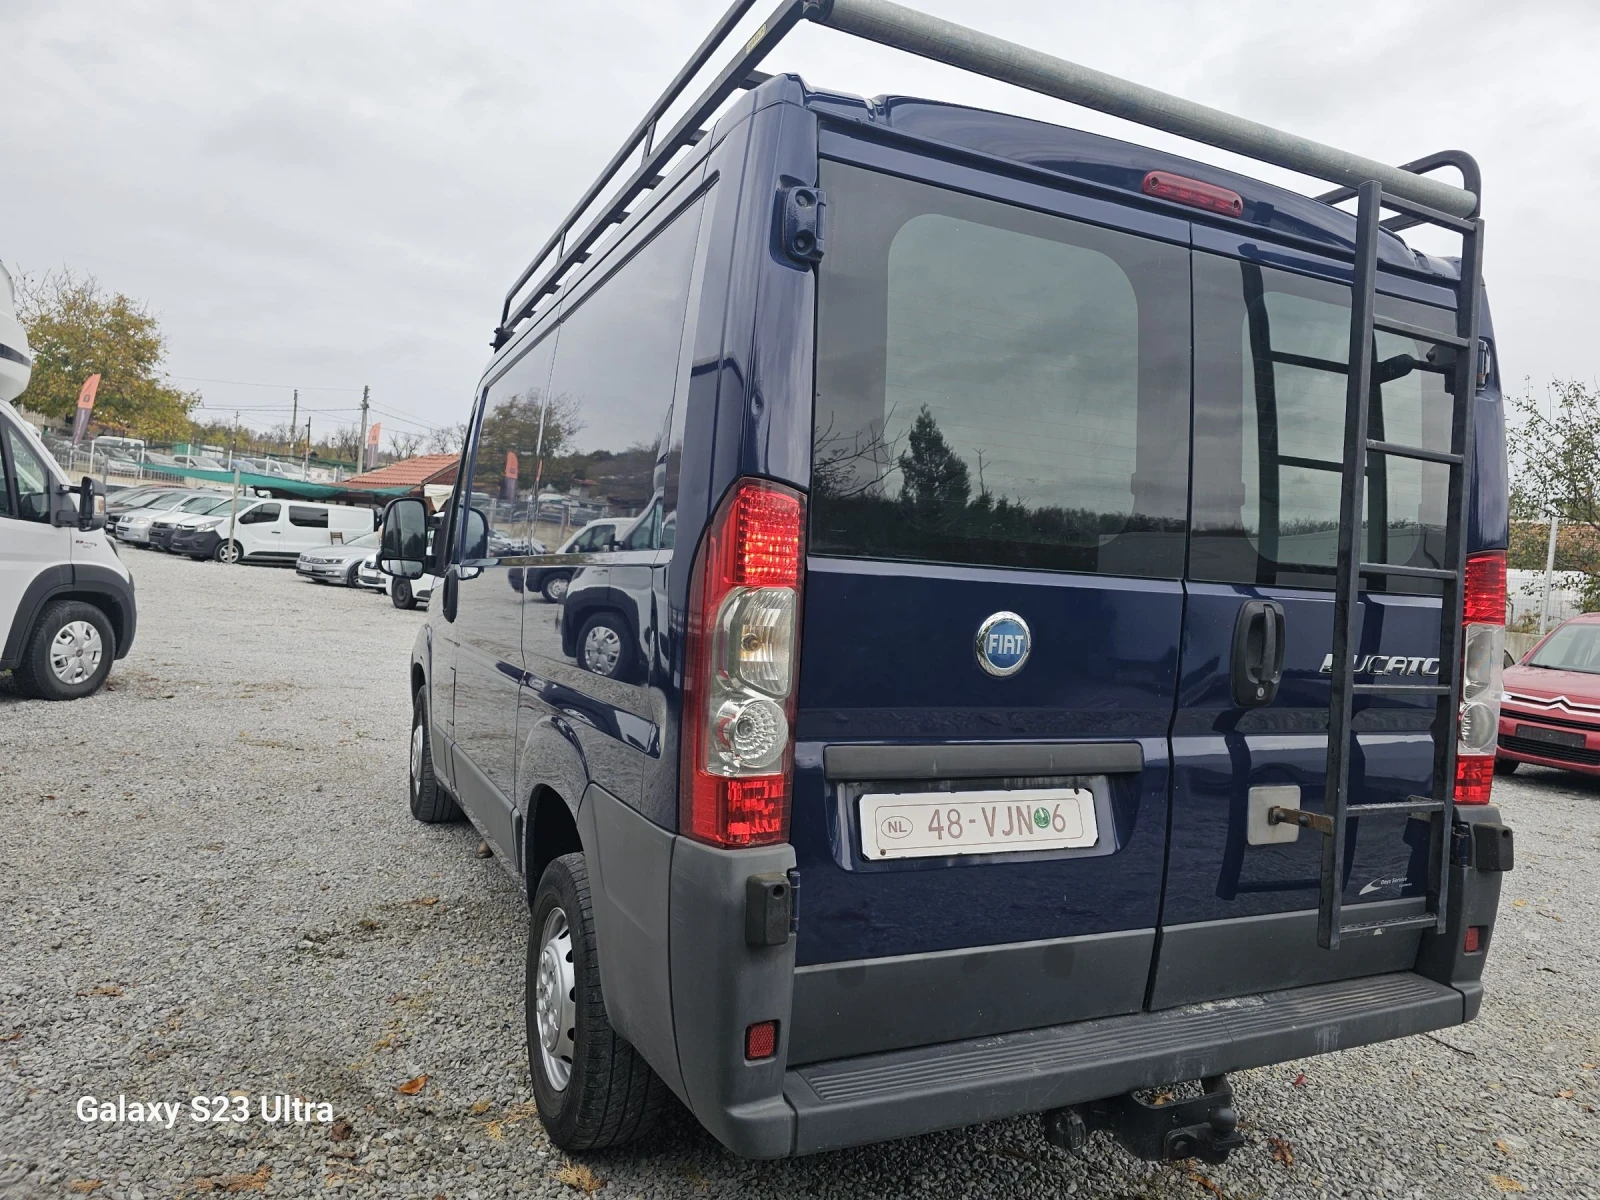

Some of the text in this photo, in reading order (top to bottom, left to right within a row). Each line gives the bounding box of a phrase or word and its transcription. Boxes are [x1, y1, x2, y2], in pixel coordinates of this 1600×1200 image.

[987, 634, 1024, 655] FIAT
[887, 820, 908, 834] NL
[928, 803, 1066, 840] 48-VJN6
